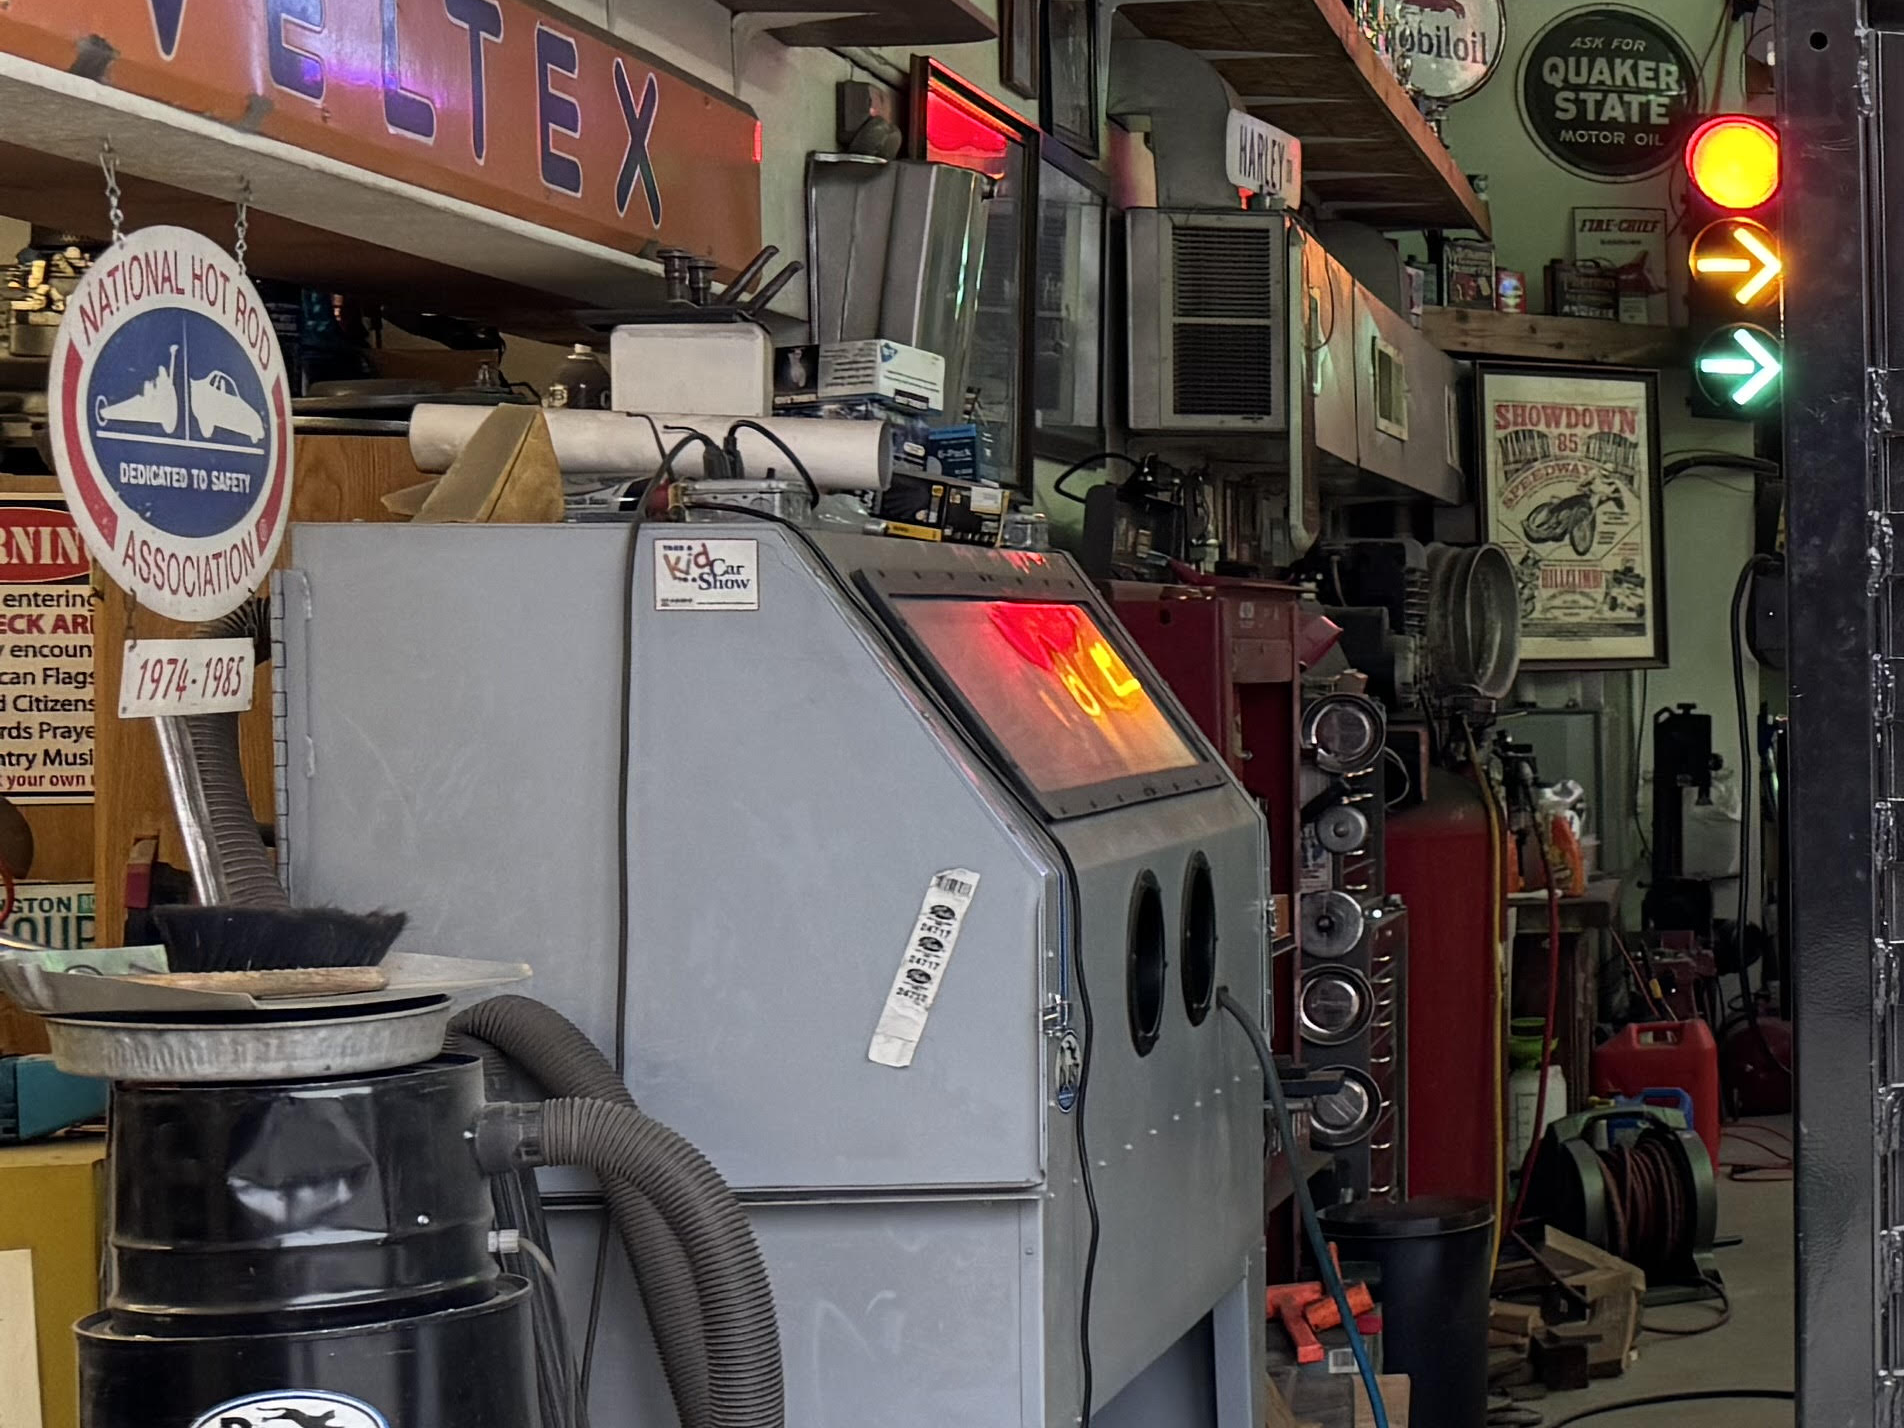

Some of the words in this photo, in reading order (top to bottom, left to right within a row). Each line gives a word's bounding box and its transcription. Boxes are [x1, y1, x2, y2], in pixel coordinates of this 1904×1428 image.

[1570, 37, 1605, 50] ASK
[1613, 38, 1646, 52] FOR
[1542, 58, 1681, 91] QUAKER
[1554, 92, 1671, 125] STATE
[1560, 130, 1624, 146] MOTOR
[1634, 132, 1664, 148] OIL
[1240, 124, 1284, 191] HARLEY
[1579, 219, 1659, 233] FIRE-CHIEF
[78, 250, 186, 345] NATIONAL
[192, 260, 231, 314] HOT
[233, 290, 272, 371] ROD
[1495, 403, 1638, 435] SHOWDOWN
[1558, 433, 1578, 453] 85
[119, 461, 188, 488] DEDICATED
[191, 467, 208, 490] TO
[210, 468, 251, 496] SAFETY
[1503, 462, 1595, 508] SPEEDWAY
[123, 531, 258, 598] ASSOCIATION
[710, 558, 744, 577] Car
[699, 573, 750, 590] Show
[135, 656, 242, 702] 1974-1985
[7, 774, 46, 789] your
[49, 775, 86, 785] own
